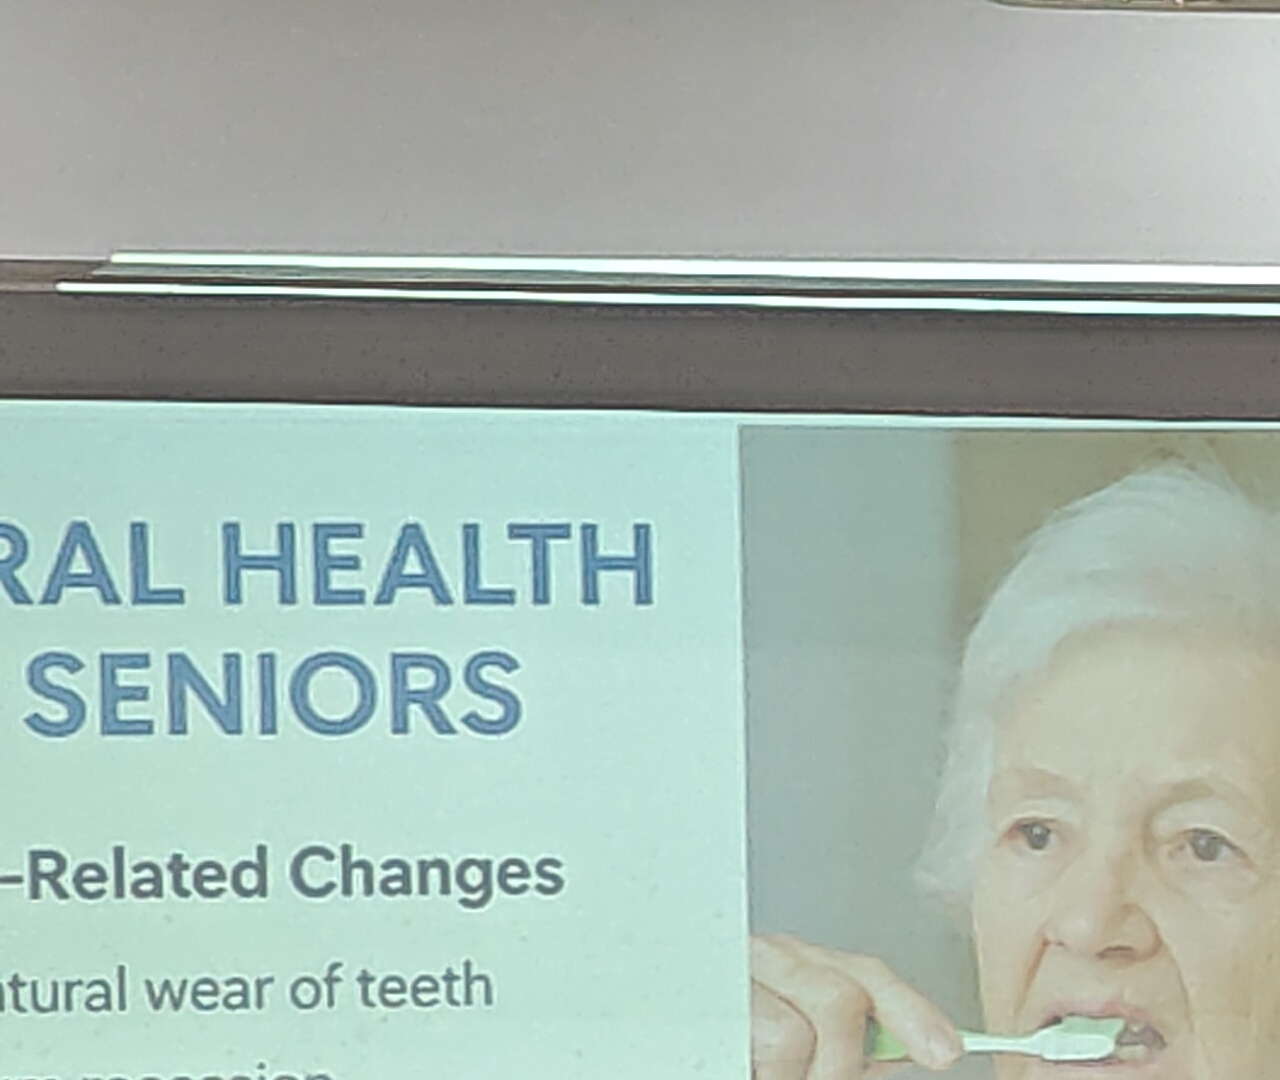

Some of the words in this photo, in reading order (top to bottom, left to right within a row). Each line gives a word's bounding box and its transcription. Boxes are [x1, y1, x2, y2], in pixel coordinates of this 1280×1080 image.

[221, 522, 655, 607] HEALTH
[23, 651, 524, 738] SENIORS
[289, 845, 566, 908] Changes
[145, 973, 275, 1012] wear
[289, 961, 345, 1010] of
[356, 959, 495, 1008] teeth
